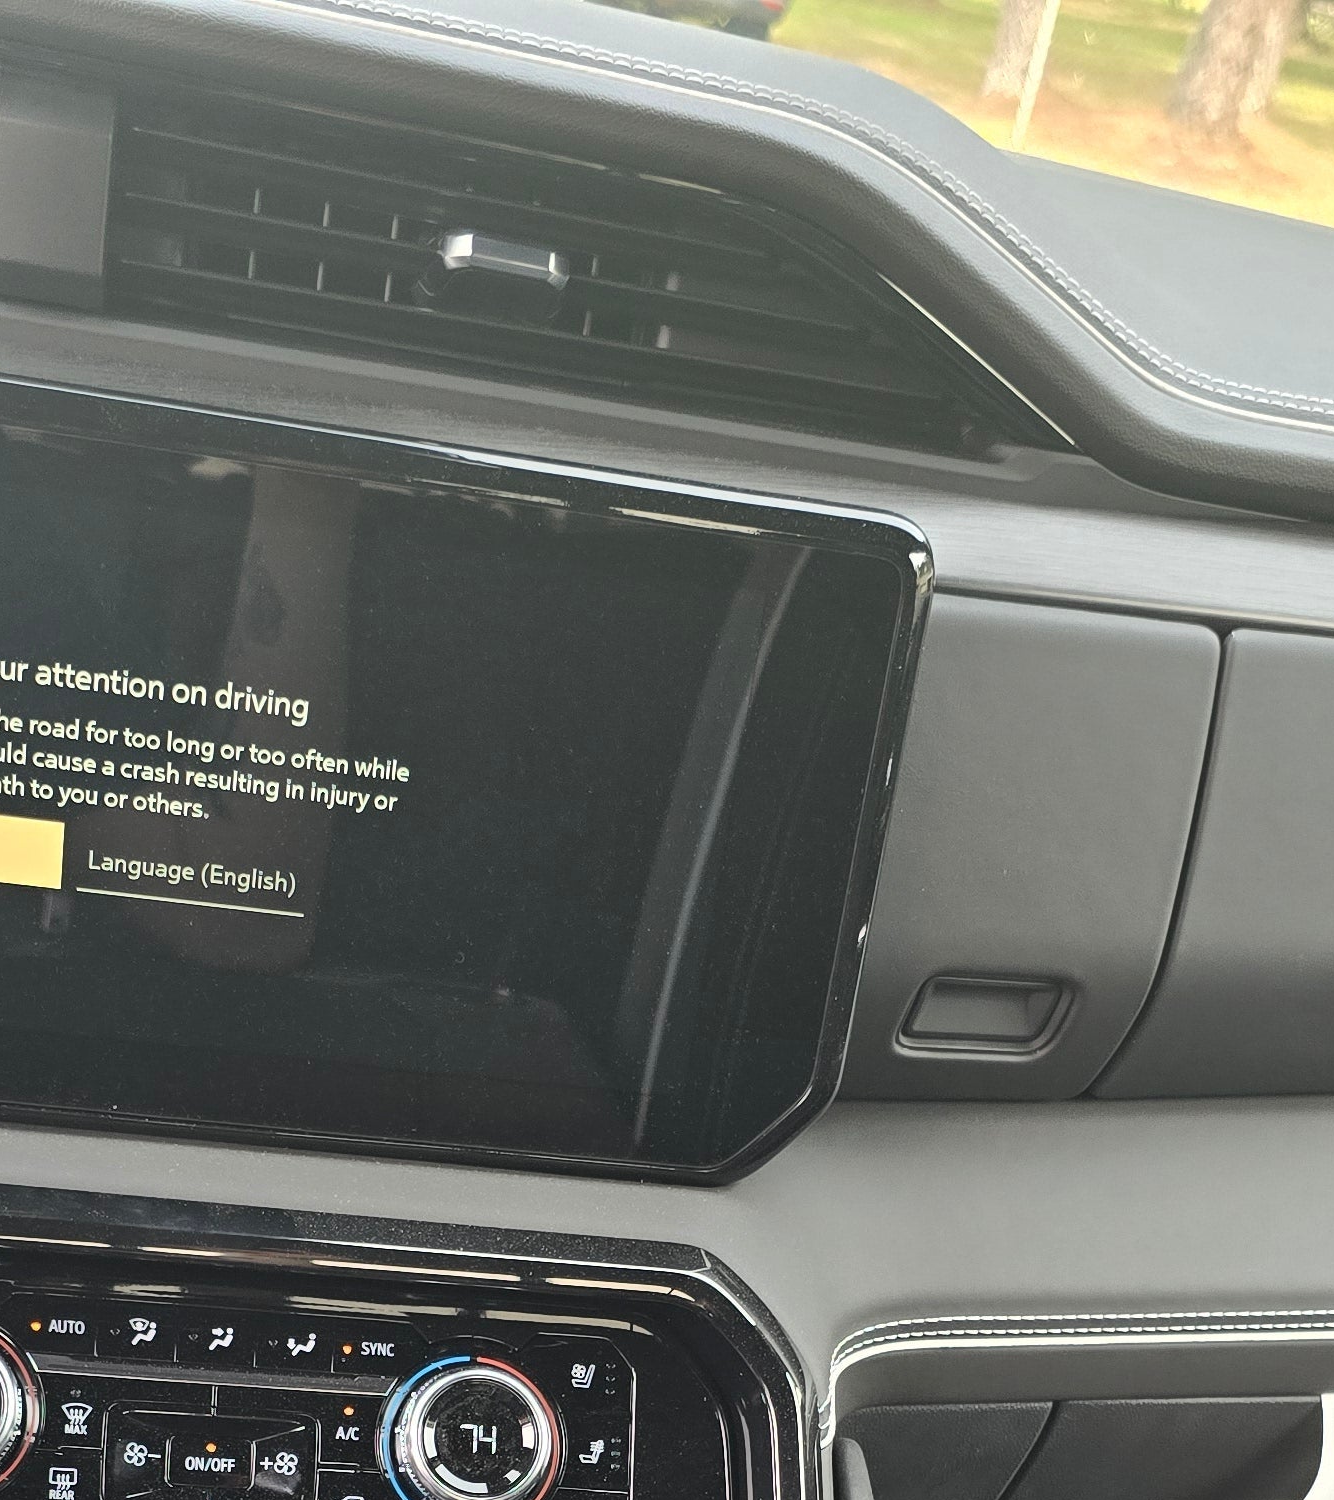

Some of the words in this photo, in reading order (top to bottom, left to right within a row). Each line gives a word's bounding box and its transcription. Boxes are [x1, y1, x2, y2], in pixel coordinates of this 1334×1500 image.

[34, 663, 165, 701] attention
[171, 683, 207, 707] on
[214, 682, 309, 727] driving
[29, 718, 80, 741] road
[84, 720, 119, 745] for
[123, 727, 160, 750] too
[167, 731, 215, 762] long
[220, 744, 245, 761] or
[249, 744, 285, 766] too
[290, 748, 349, 775] often
[354, 756, 410, 783] while
[32, 751, 96, 774] cause
[101, 760, 115, 776] a
[120, 762, 179, 786] crash
[185, 769, 280, 803] resulting
[285, 778, 304, 800] in
[310, 781, 370, 814] injury
[373, 793, 398, 812] or
[29, 777, 54, 800] to
[57, 786, 98, 807] you
[103, 791, 129, 809] or
[132, 791, 210, 820] others.
[88, 849, 196, 882] Language
[200, 862, 297, 899] (English)
[48, 1319, 86, 1335] AUTO
[360, 1341, 395, 1357] SYNC
[64, 1424, 88, 1436] MAX
[335, 1426, 360, 1441] A/C
[460, 1423, 497, 1455] 74
[184, 1456, 236, 1473] ON/OFF
[48, 1489, 75, 1500] REAR
